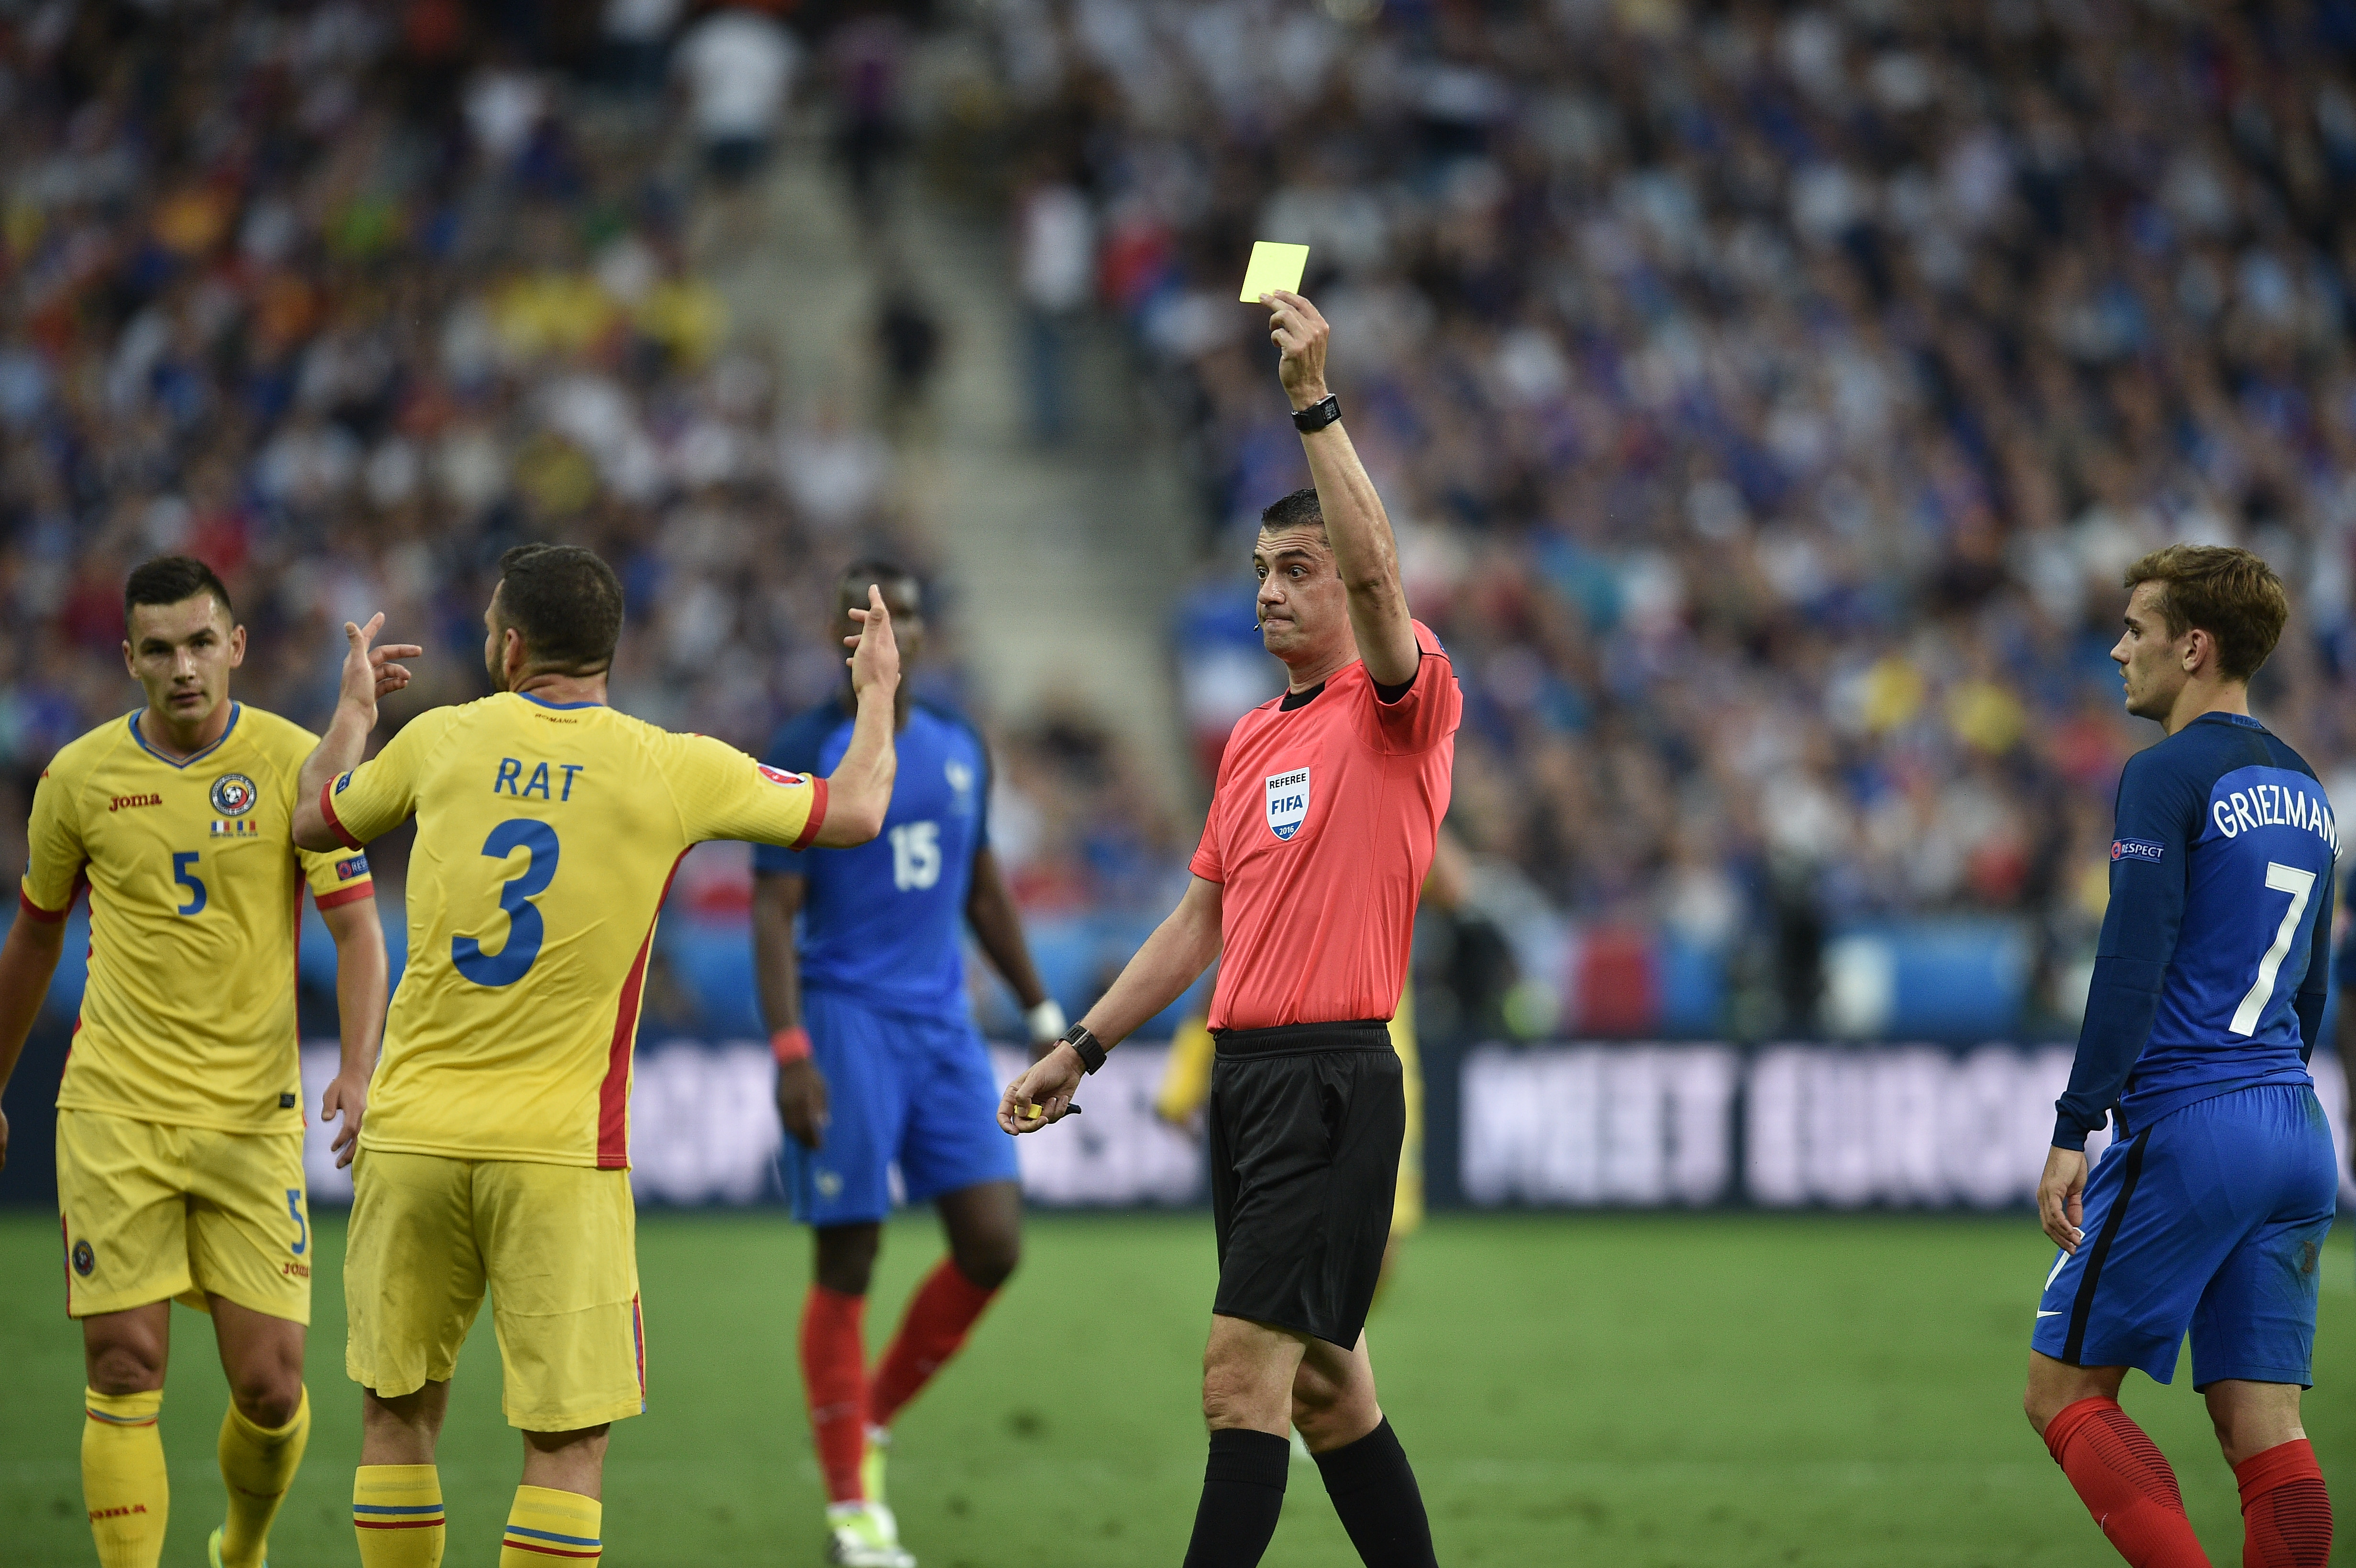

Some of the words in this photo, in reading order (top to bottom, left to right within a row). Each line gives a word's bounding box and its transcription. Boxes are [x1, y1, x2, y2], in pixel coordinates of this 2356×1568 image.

[494, 757, 584, 801] RAT
[1269, 773, 1306, 789] REFEREE
[1272, 795, 1303, 815] FIFA
[889, 820, 941, 892] 15
[1279, 826, 1294, 835] 2016
[2121, 843, 2164, 858] RESPECT
[173, 851, 207, 915] 5
[451, 818, 560, 987] 3
[2228, 861, 2317, 1037] 7
[287, 1189, 305, 1255] 5
